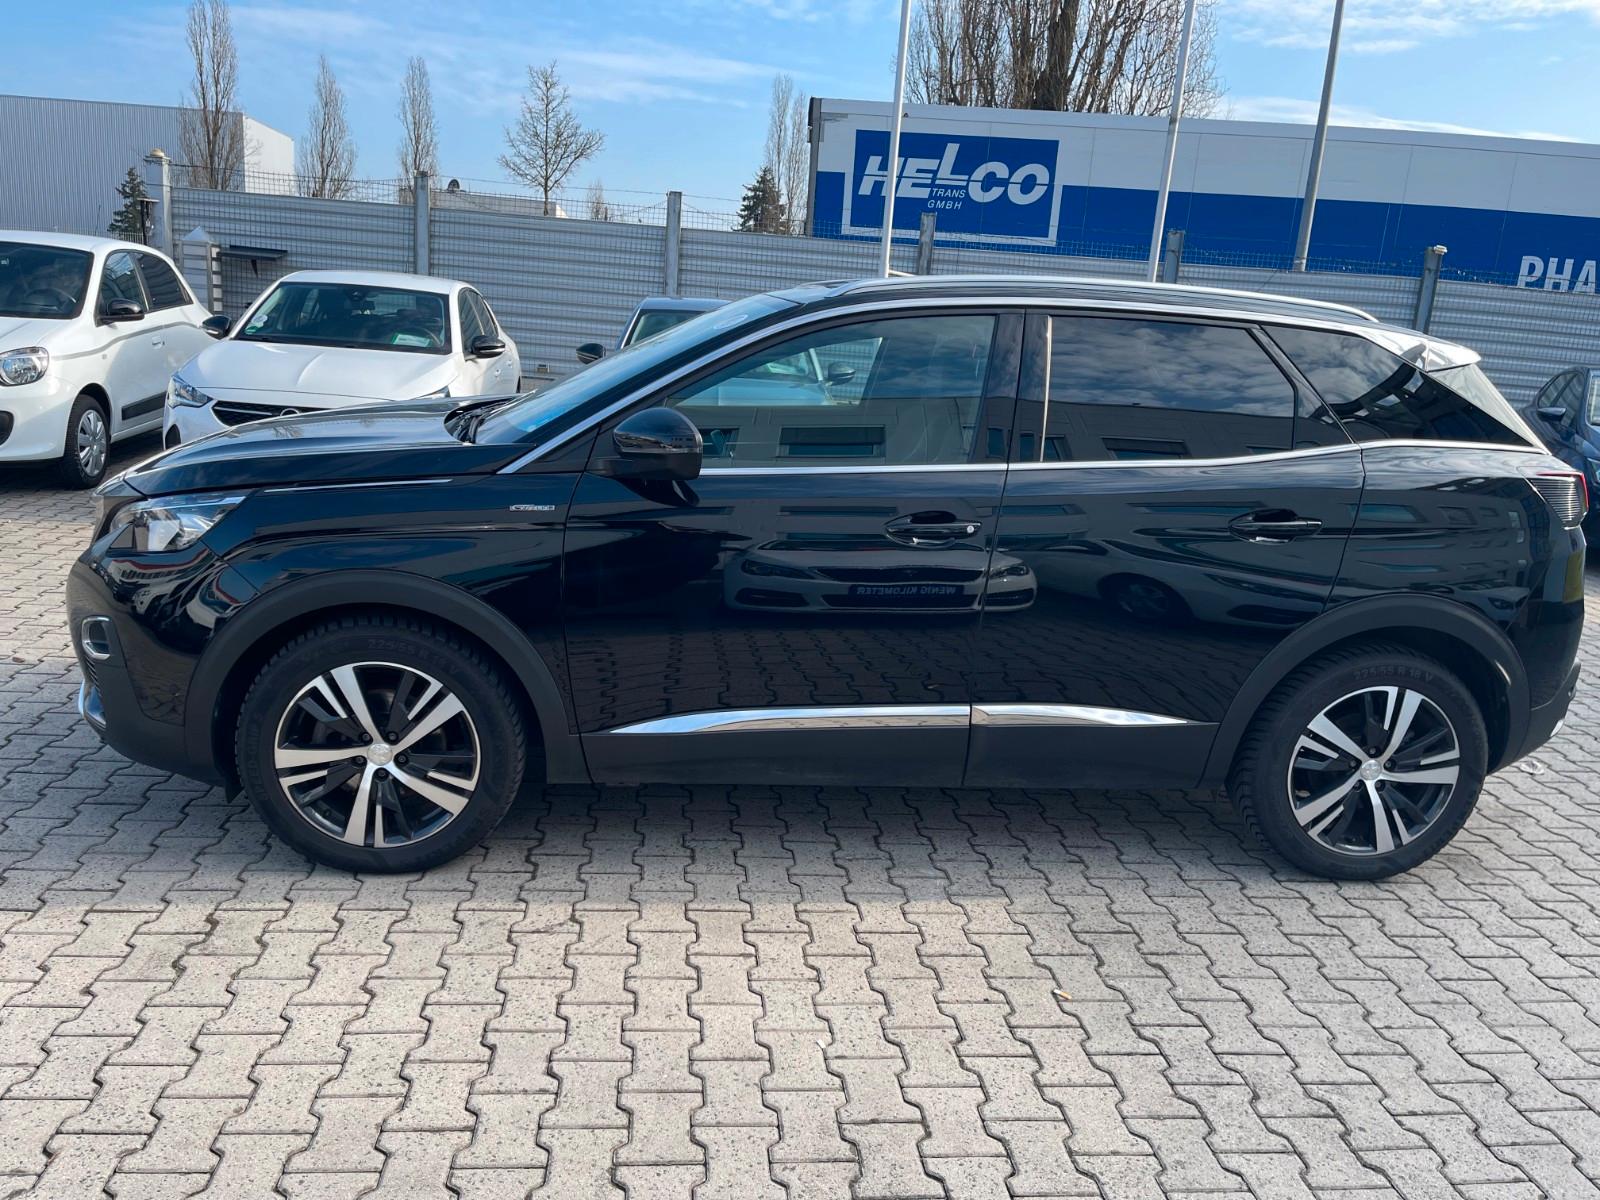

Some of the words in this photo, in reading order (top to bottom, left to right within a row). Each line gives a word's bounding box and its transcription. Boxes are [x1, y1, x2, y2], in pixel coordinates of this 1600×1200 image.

[858, 143, 1050, 205] HELCO
[927, 200, 962, 210] GMBH
[932, 188, 966, 198] TRANS
[1517, 255, 1597, 294] PHA
